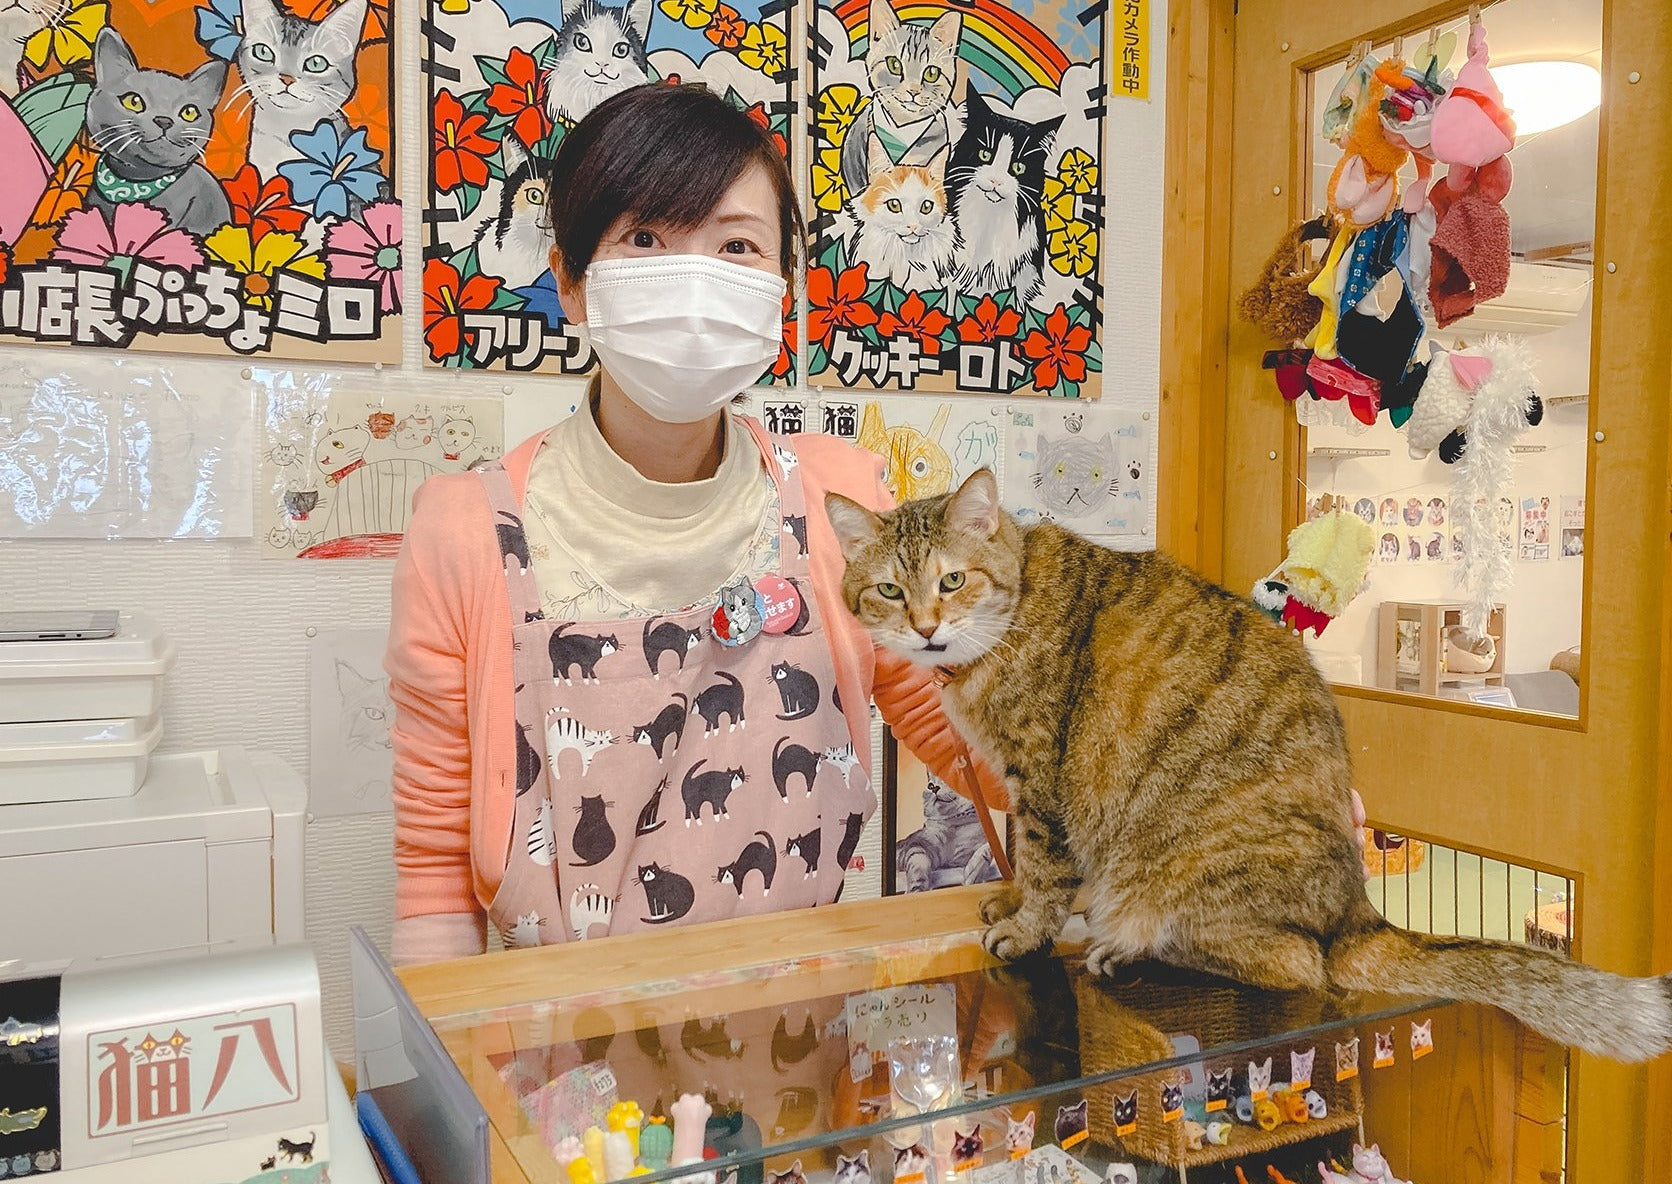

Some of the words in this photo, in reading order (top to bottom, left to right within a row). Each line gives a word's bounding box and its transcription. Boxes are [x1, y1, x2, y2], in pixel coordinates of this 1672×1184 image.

[1122, 0, 1140, 93] カメラ作動中
[831, 329, 940, 388] クッキー
[959, 341, 1027, 390] ロト
[823, 404, 857, 437] 猫
[964, 430, 995, 465] ガ
[96, 1017, 294, 1131] 猫八
